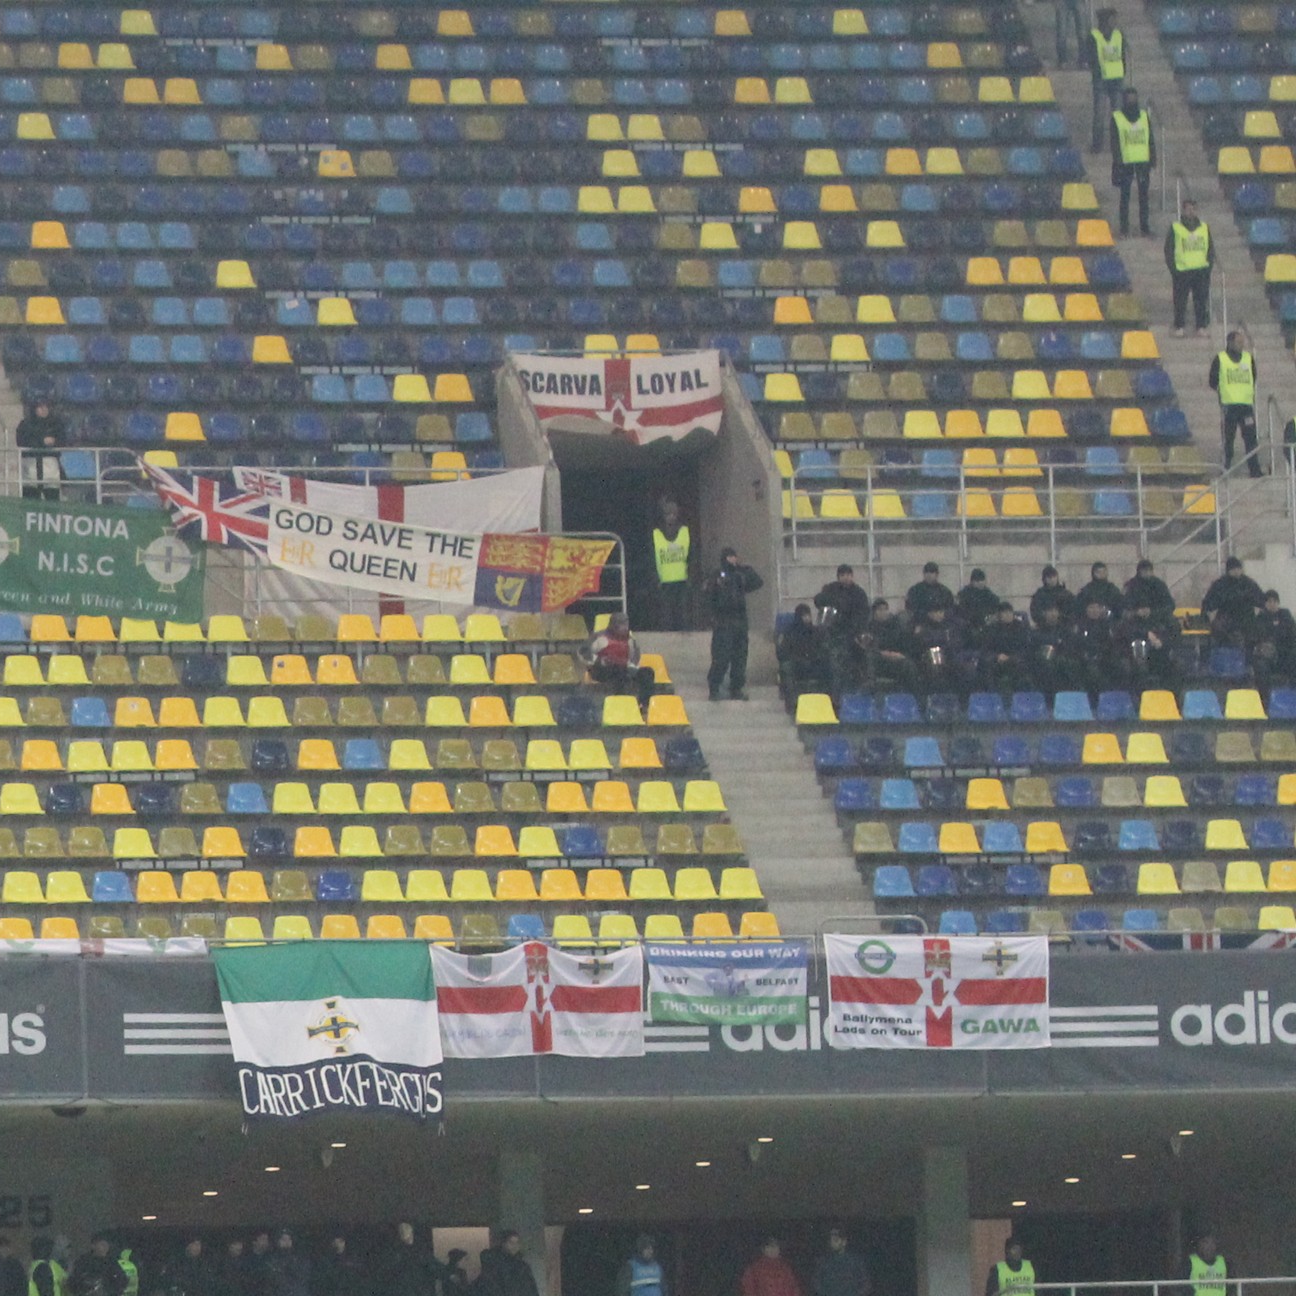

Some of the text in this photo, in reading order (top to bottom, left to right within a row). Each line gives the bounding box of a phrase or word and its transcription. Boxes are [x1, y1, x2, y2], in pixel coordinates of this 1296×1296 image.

[519, 368, 709, 396] SCARVA LOYAL
[25, 512, 129, 540] FINTONA
[274, 508, 476, 560] GOD SAVE THE
[37, 551, 115, 577] N.I.S.C
[328, 549, 417, 583] QUEEN
[130, 597, 179, 617] Army
[650, 946, 800, 958] DRINKING OUR WAY
[663, 976, 799, 987] EAST BELFAST
[660, 1000, 797, 1016] THROUGH EUROPE
[843, 1013, 913, 1025] Ballymena
[960, 1018, 1041, 1034] GAWA
[834, 1025, 923, 1036] Lads on Tour
[239, 1060, 442, 1118] CARRICKFERGUS
